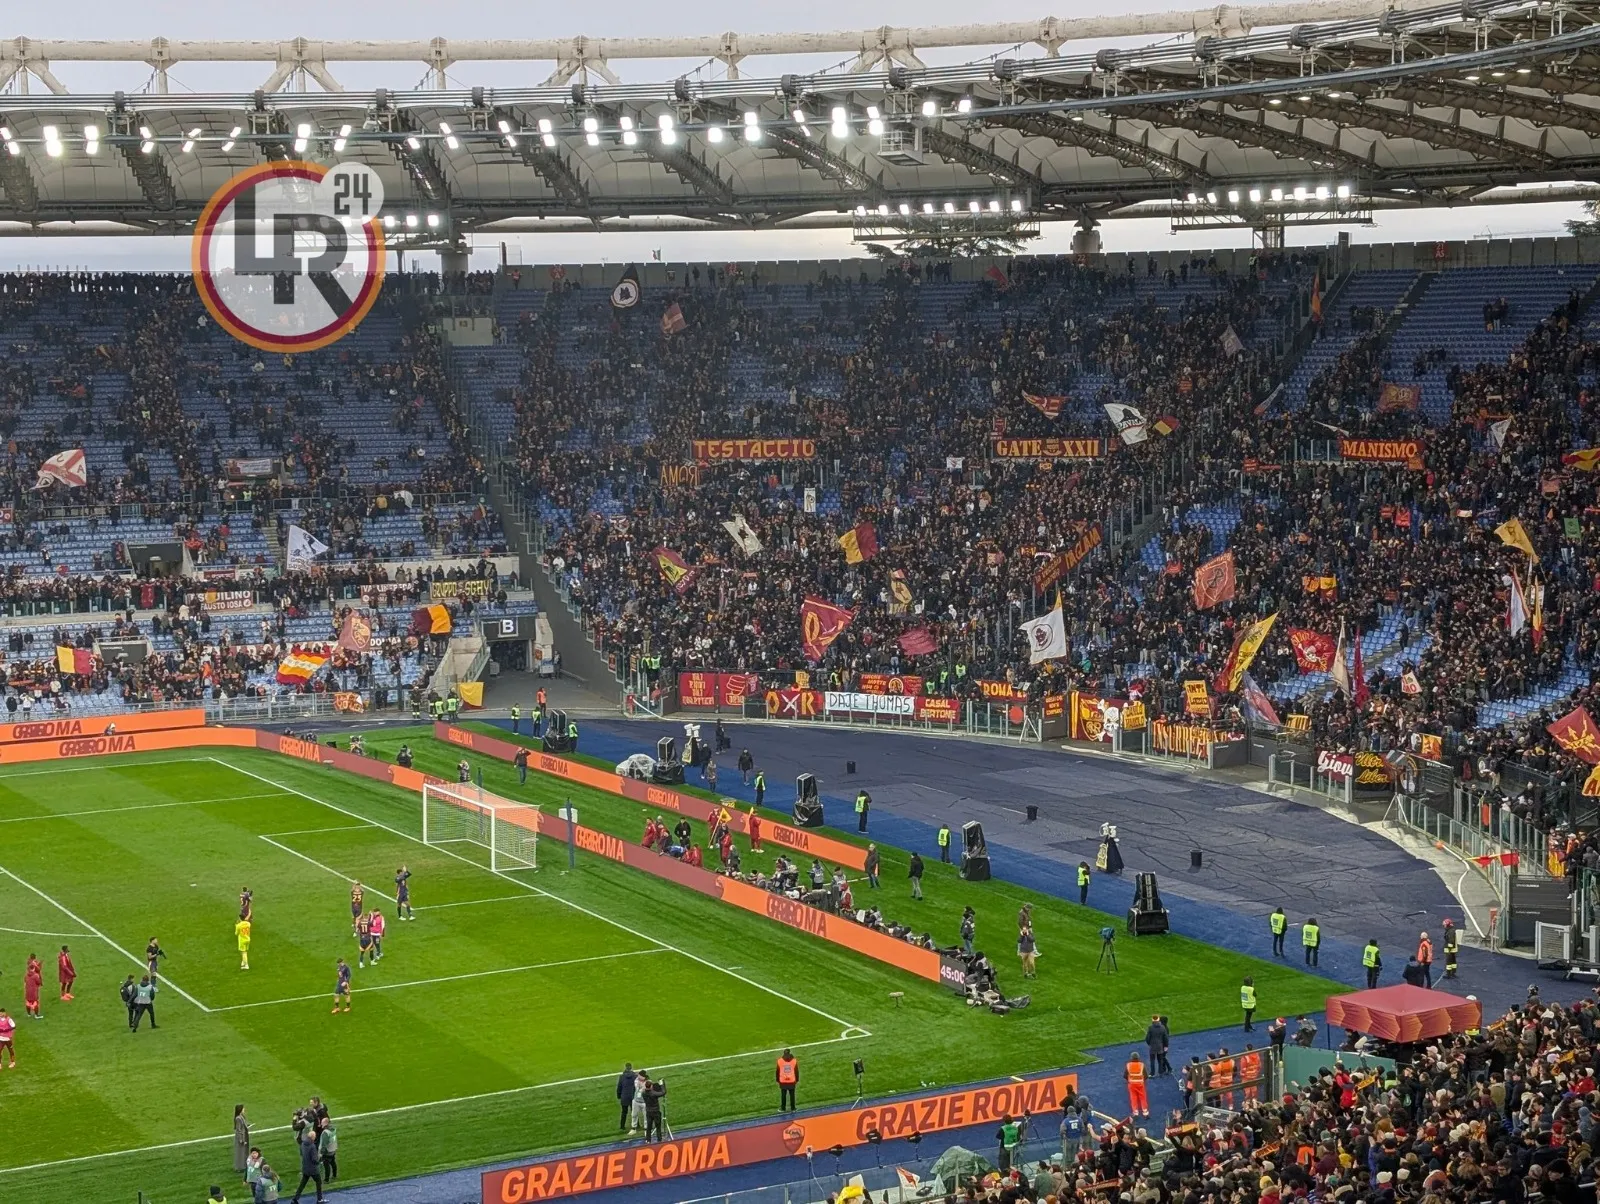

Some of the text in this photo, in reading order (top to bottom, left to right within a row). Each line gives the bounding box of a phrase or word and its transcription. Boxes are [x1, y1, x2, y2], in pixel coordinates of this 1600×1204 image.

[693, 439, 815, 458] TESTACCIO
[996, 440, 1042, 457] GATE
[1063, 440, 1099, 457] XXII
[1342, 440, 1418, 458] MANISMO
[502, 619, 514, 633] B
[983, 683, 1013, 697] ROMA
[829, 693, 911, 713] DAJE THOMAS
[925, 699, 951, 708] CASAL
[920, 708, 957, 720] BERTONE
[352, 894, 362, 902] 23
[361, 924, 368, 933] 11
[856, 1080, 1057, 1141] GRAZIE ROMA
[500, 1135, 730, 1203] GRAZIE ROMA
